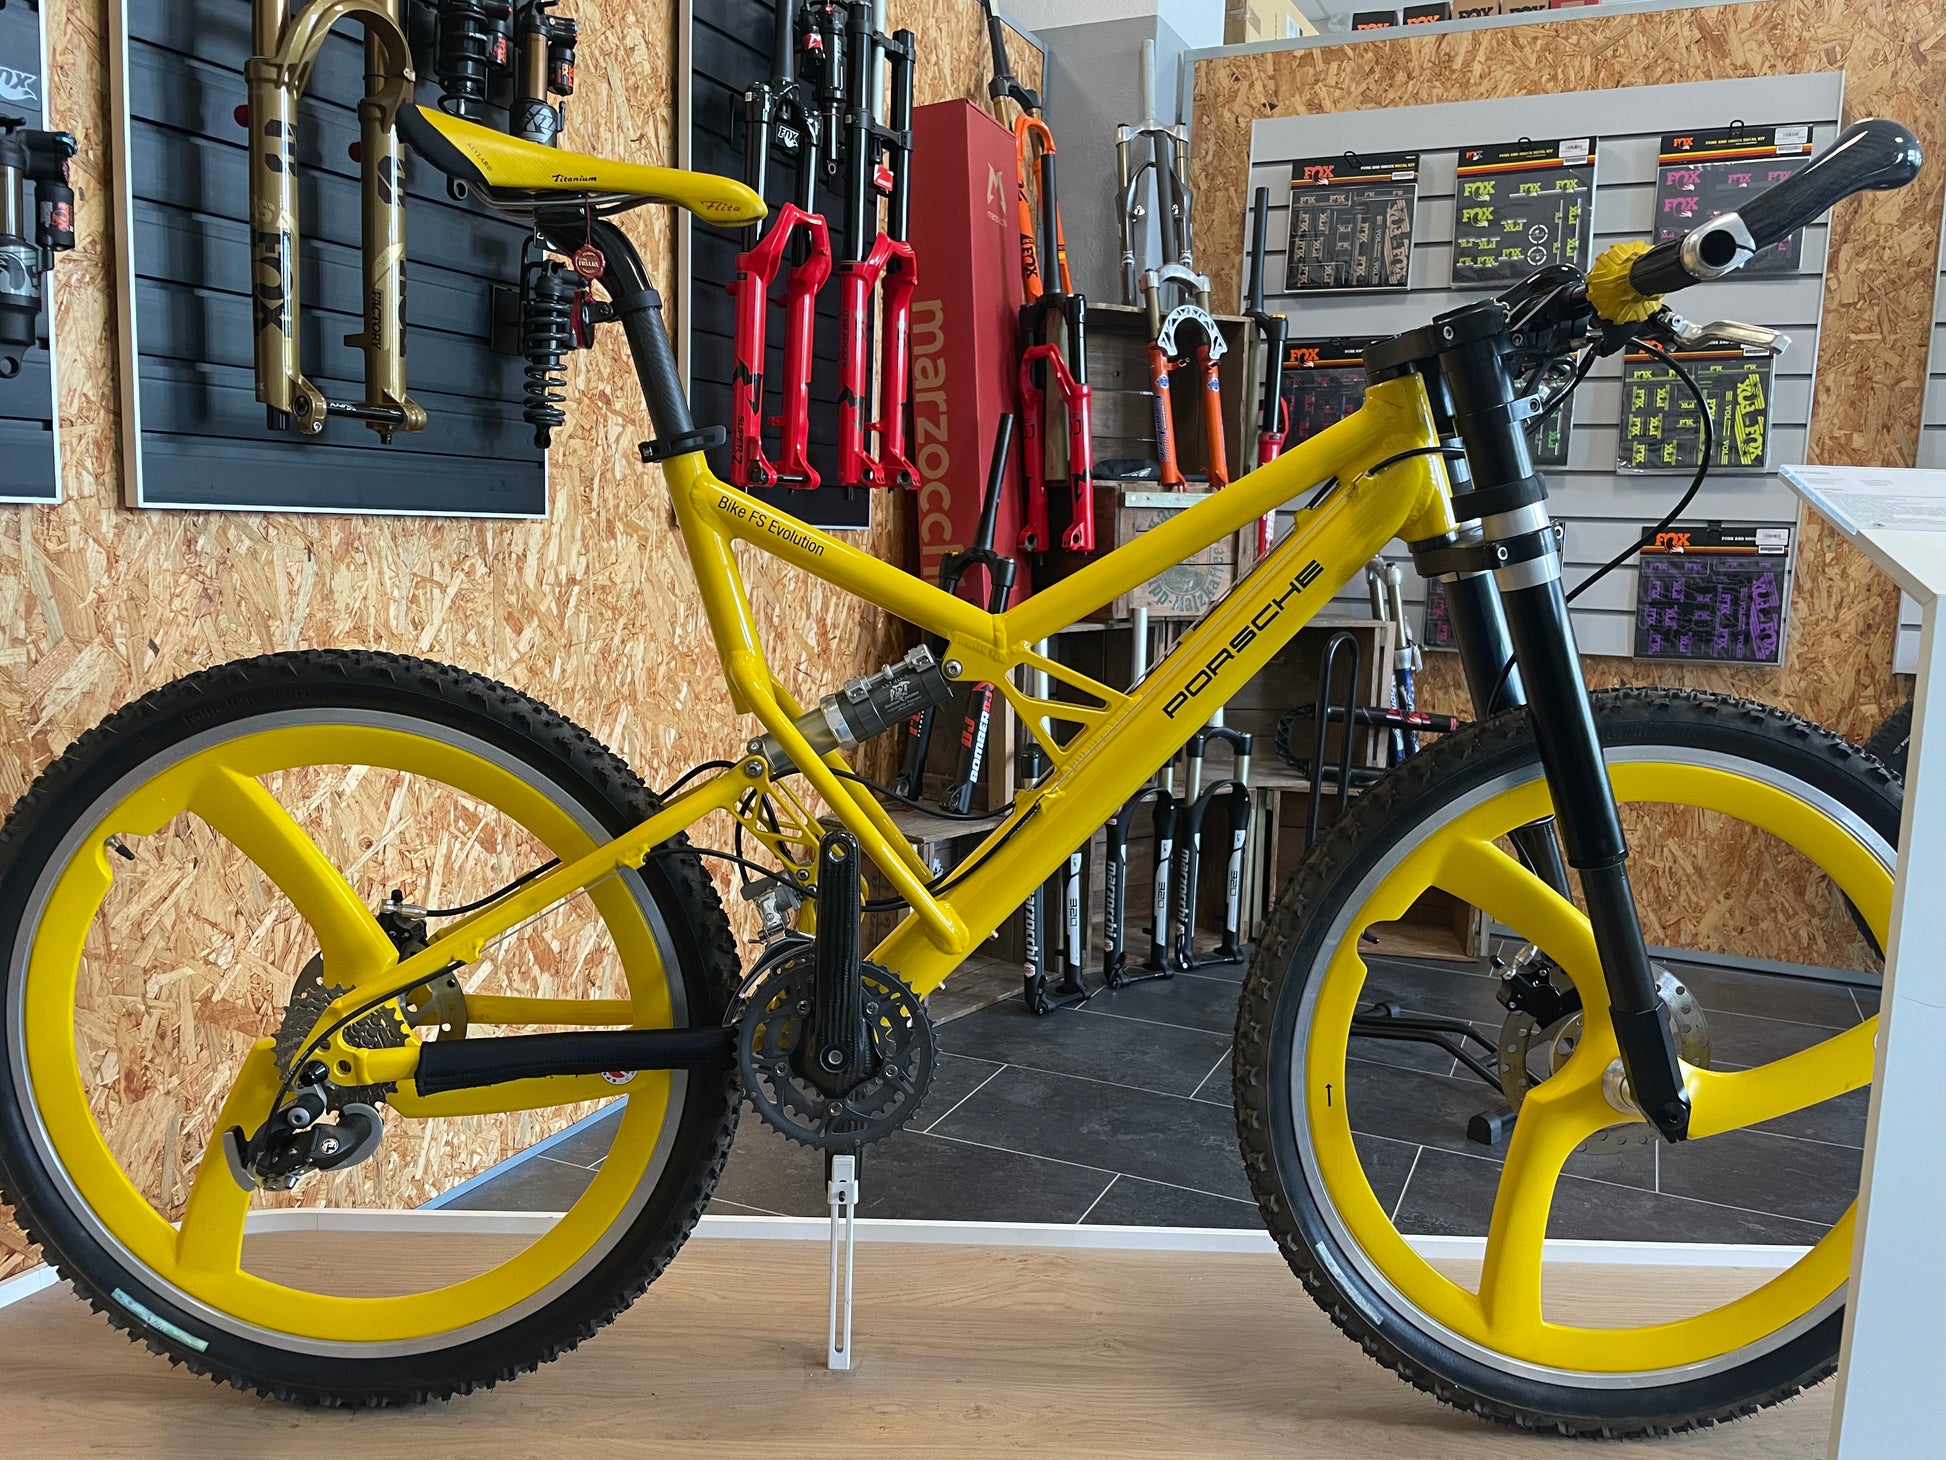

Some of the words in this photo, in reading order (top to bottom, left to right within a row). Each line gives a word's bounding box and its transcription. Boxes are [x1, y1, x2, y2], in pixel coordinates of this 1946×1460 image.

[778, 126, 799, 147] FOX
[1673, 137, 1694, 149] FOX
[552, 174, 597, 183] Titanium
[1303, 165, 1335, 185] FOX
[1666, 170, 1701, 190] FOX
[1728, 173, 1752, 187] FOX
[1464, 181, 1495, 201] FOX
[1520, 183, 1541, 196] FOX
[1556, 179, 1578, 192] FOX
[700, 201, 740, 213] Flite
[1462, 207, 1494, 227] FOX
[1664, 197, 1699, 217] FOX
[1021, 245, 1038, 280] FOX
[253, 231, 293, 336] FOX
[371, 291, 382, 350] FACTORY
[1290, 348, 1320, 367] FOX
[735, 415, 745, 452] SUPER
[718, 496, 747, 519] Bike
[748, 510, 768, 528] FS
[768, 520, 825, 557] Evolution
[1655, 533, 1691, 553] FOX
[1162, 559, 1325, 719] PORSCHE
[969, 711, 990, 783] BOMBER
[1178, 848, 1189, 922] marzocchi
[1230, 870, 1238, 896] 320
[1105, 861, 1117, 938] marzocchi
[1157, 882, 1165, 908] 320
[1025, 892, 1038, 961] arzocchi
